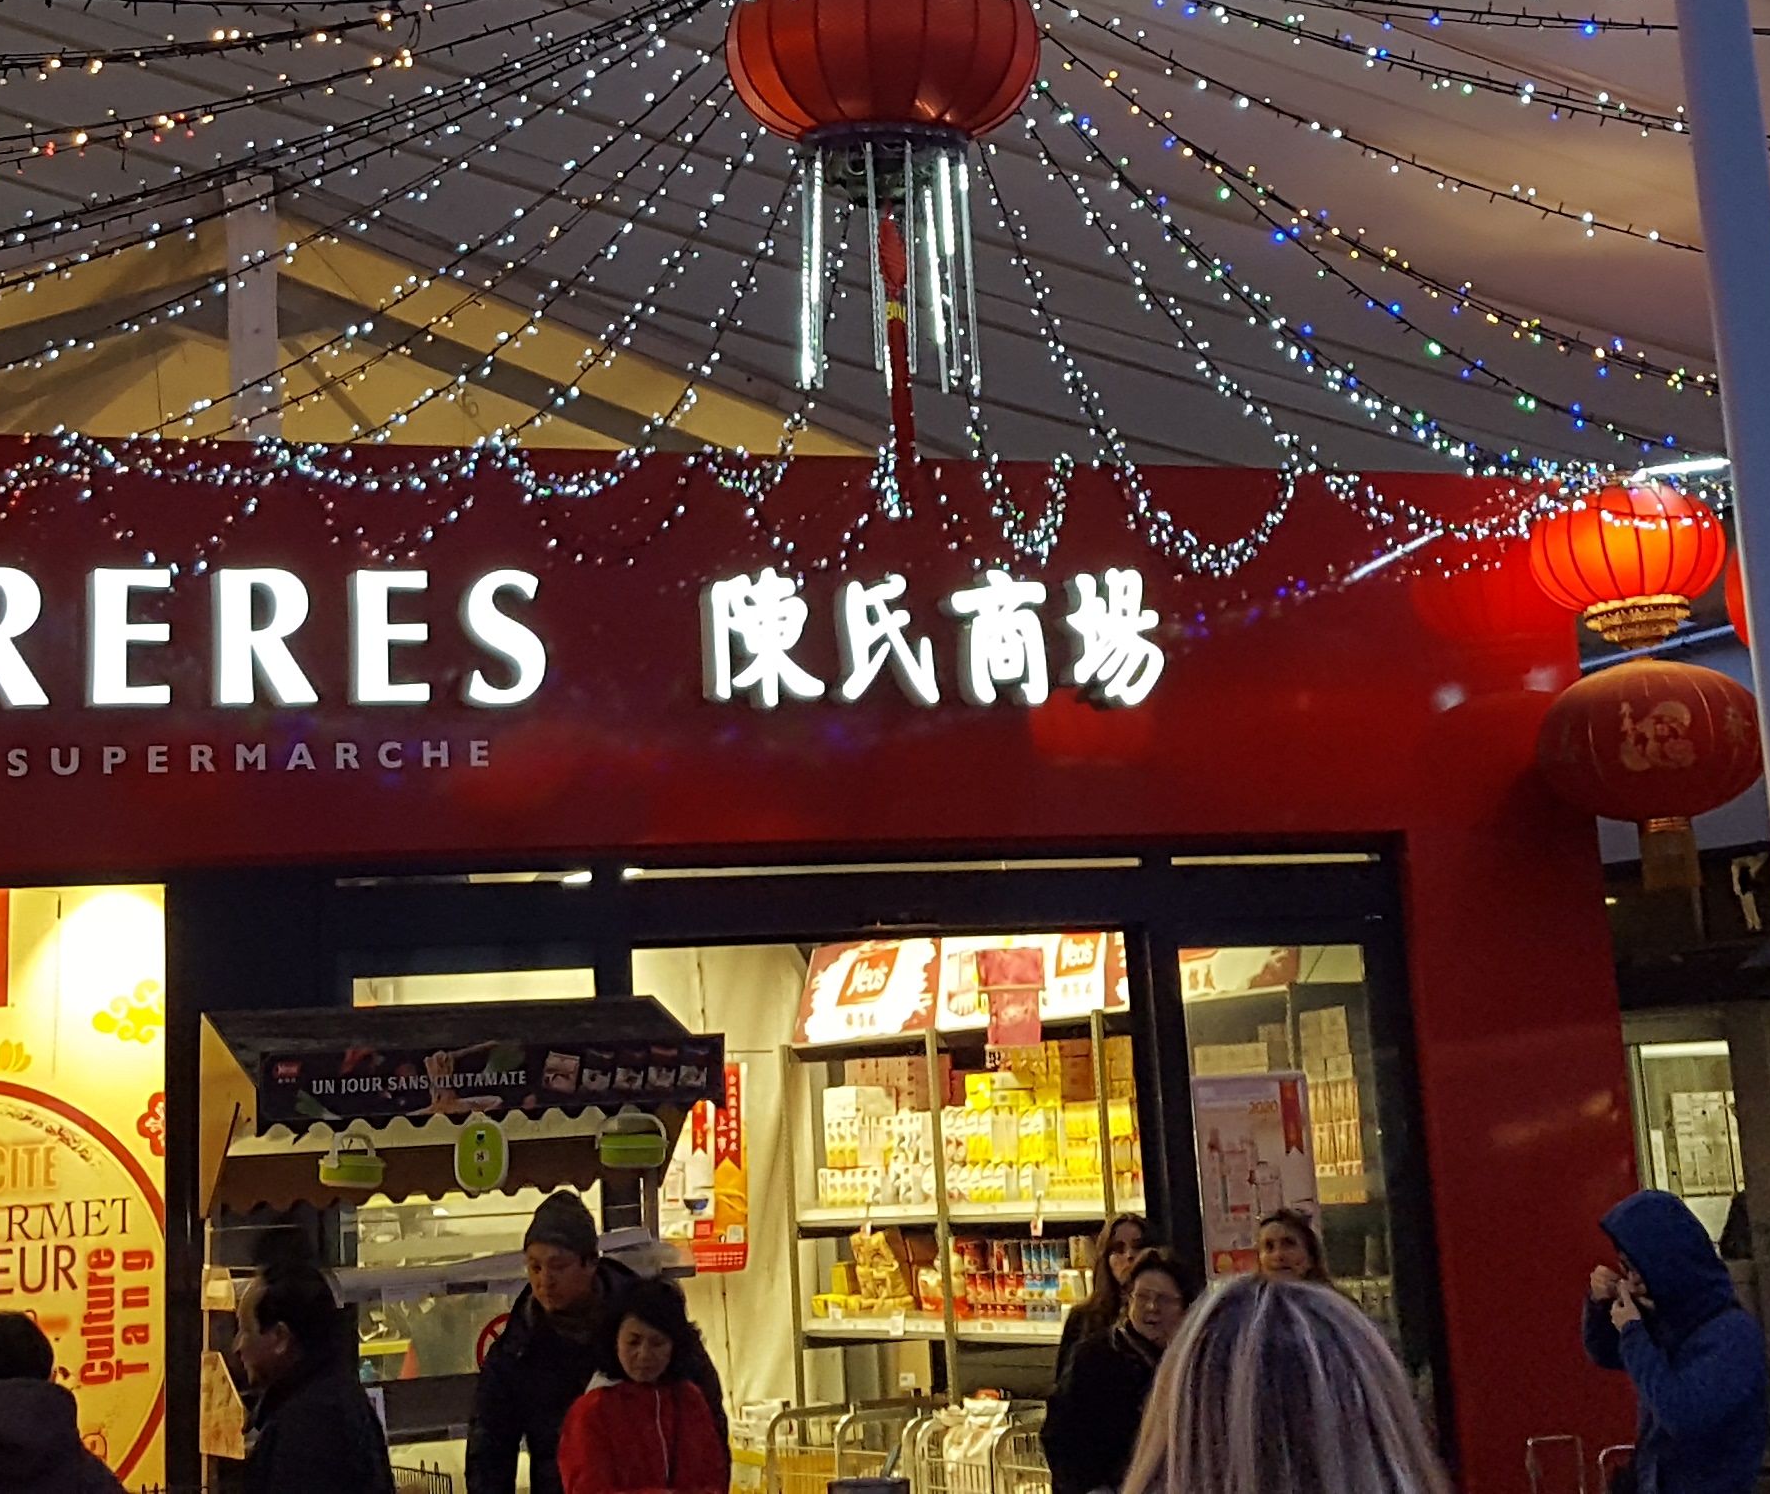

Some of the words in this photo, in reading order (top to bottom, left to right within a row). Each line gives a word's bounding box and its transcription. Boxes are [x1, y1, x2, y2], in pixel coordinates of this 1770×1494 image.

[702, 567, 1167, 708] 陳氏商場
[4, 739, 494, 778] SUPERMARCHE
[312, 1079, 336, 1096] UN
[341, 1076, 384, 1094] JOUR
[387, 1074, 429, 1092] SANS
[435, 1069, 527, 1089] GLUTAMATE
[80, 1247, 115, 1386] Culture
[115, 1249, 155, 1382] Tang
